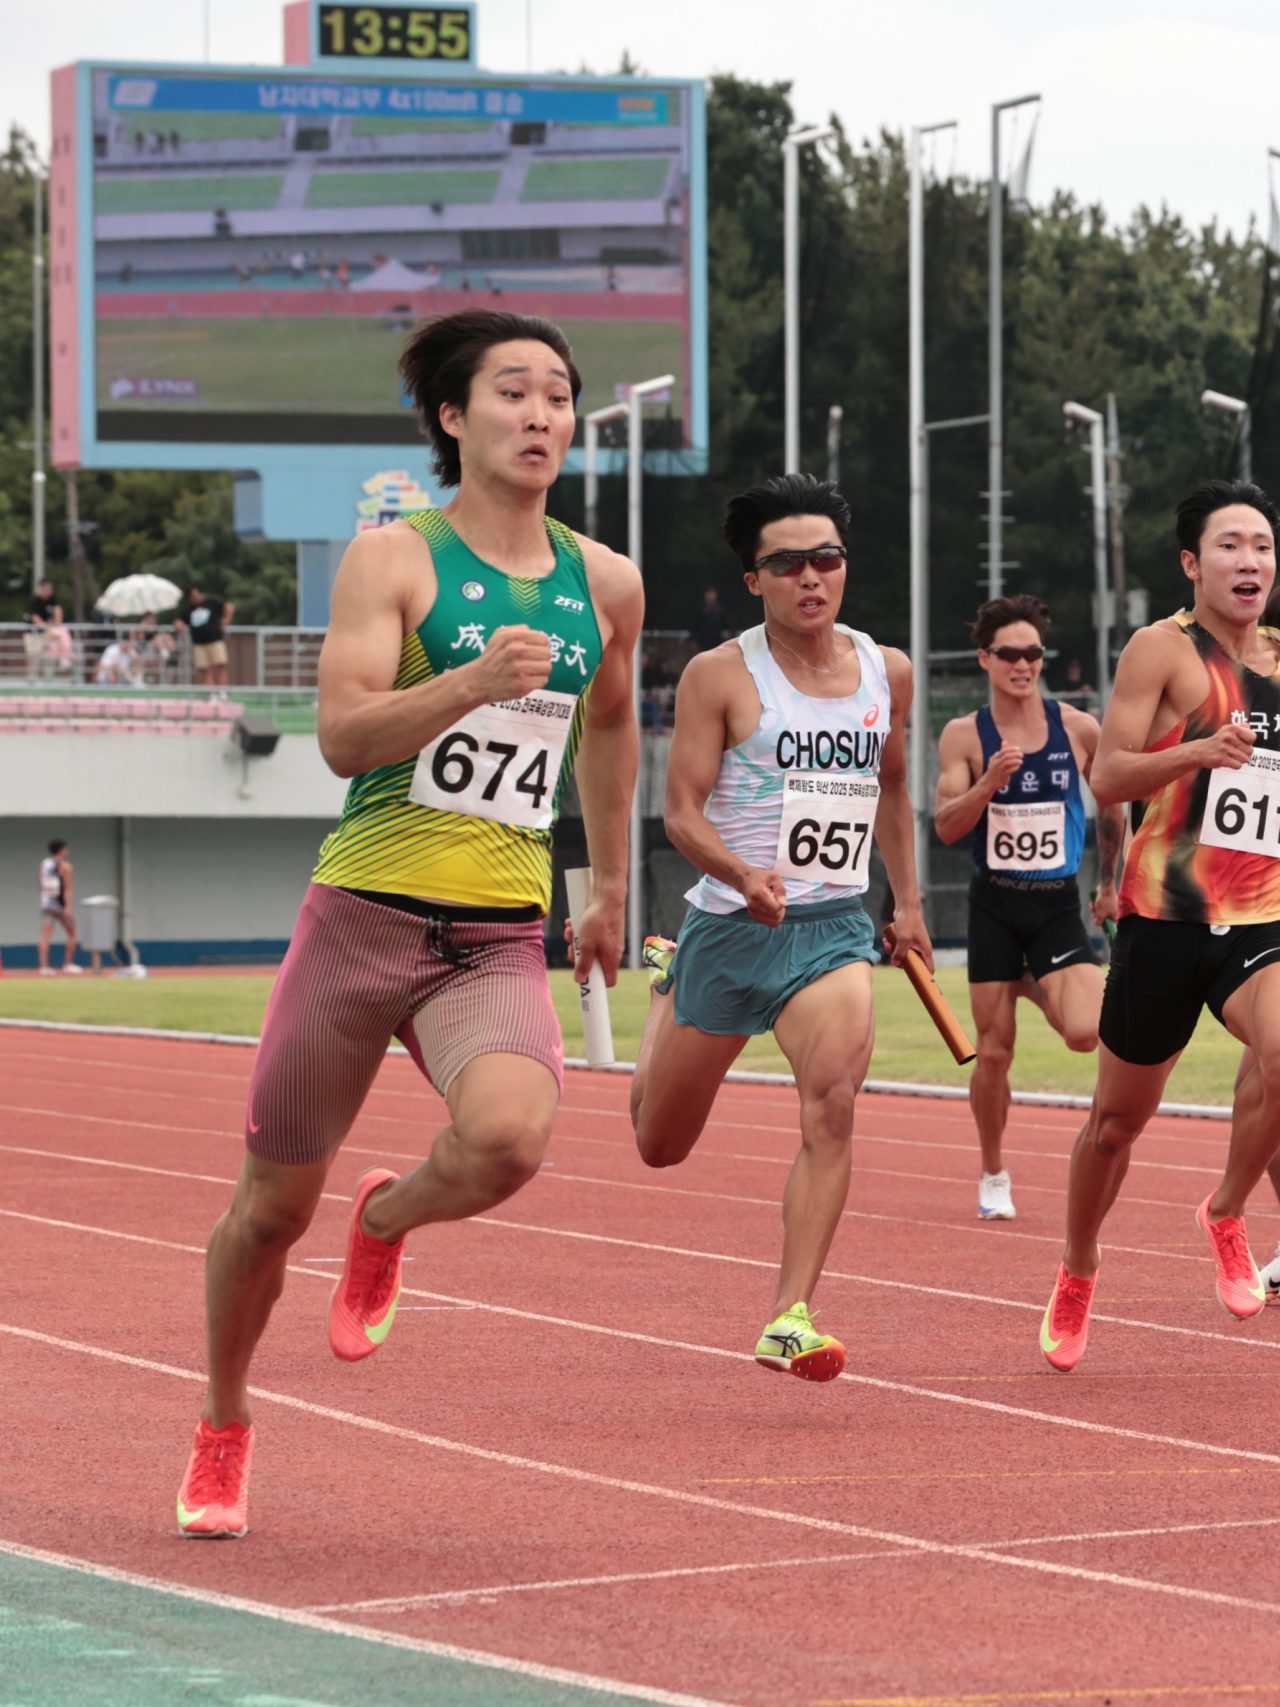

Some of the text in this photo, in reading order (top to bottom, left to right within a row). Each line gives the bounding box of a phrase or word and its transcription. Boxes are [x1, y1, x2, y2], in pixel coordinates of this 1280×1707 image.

[323, 9, 470, 58] 13:55
[776, 730, 885, 769] CHOSUN
[432, 731, 549, 809] 674
[829, 782, 848, 796] 2025
[788, 818, 869, 871] 657
[994, 830, 1059, 862] 695
[1030, 880, 1065, 890] PRO
